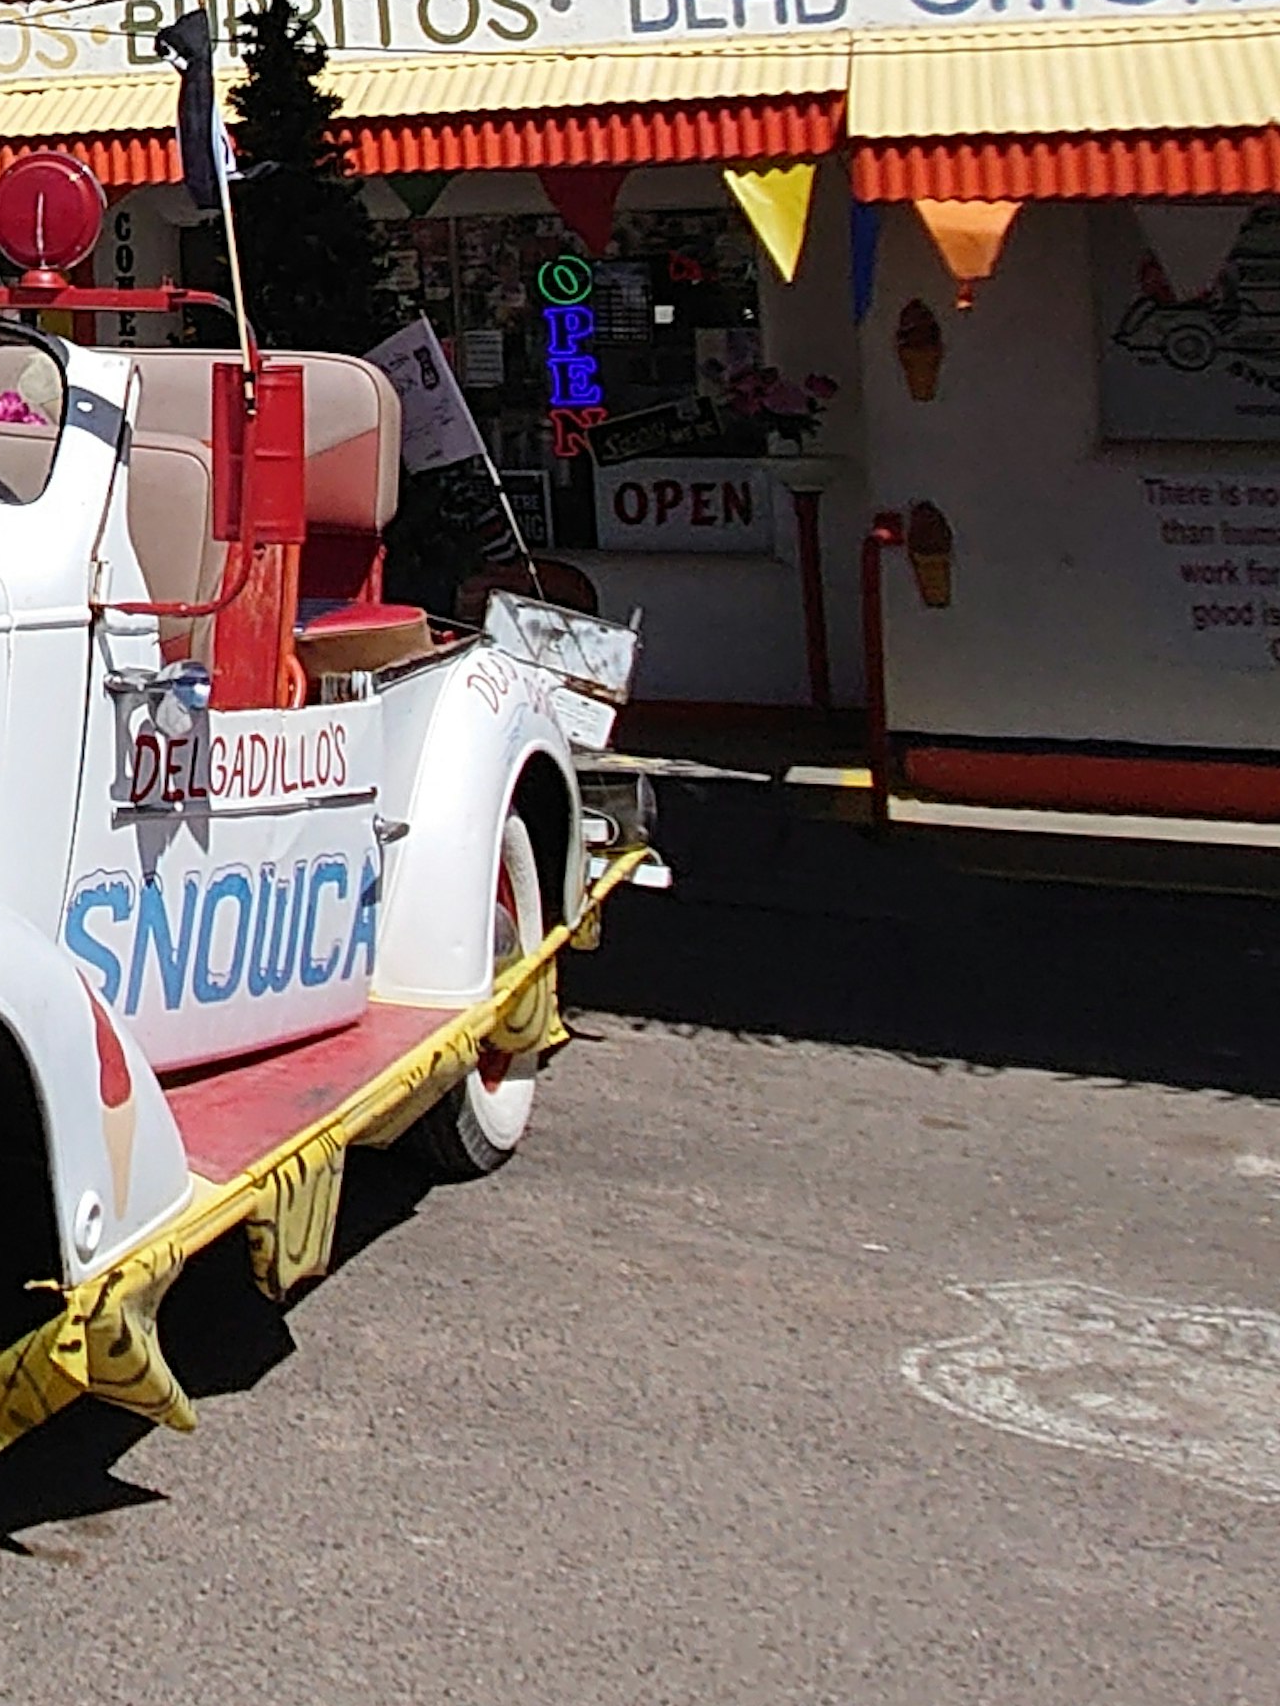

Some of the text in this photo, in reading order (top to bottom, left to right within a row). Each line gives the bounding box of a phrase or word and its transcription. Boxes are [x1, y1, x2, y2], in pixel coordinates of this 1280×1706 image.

[537, 254, 608, 457] OPEN
[612, 479, 754, 529] OPEN
[130, 722, 347, 804] DELGADILLO'S
